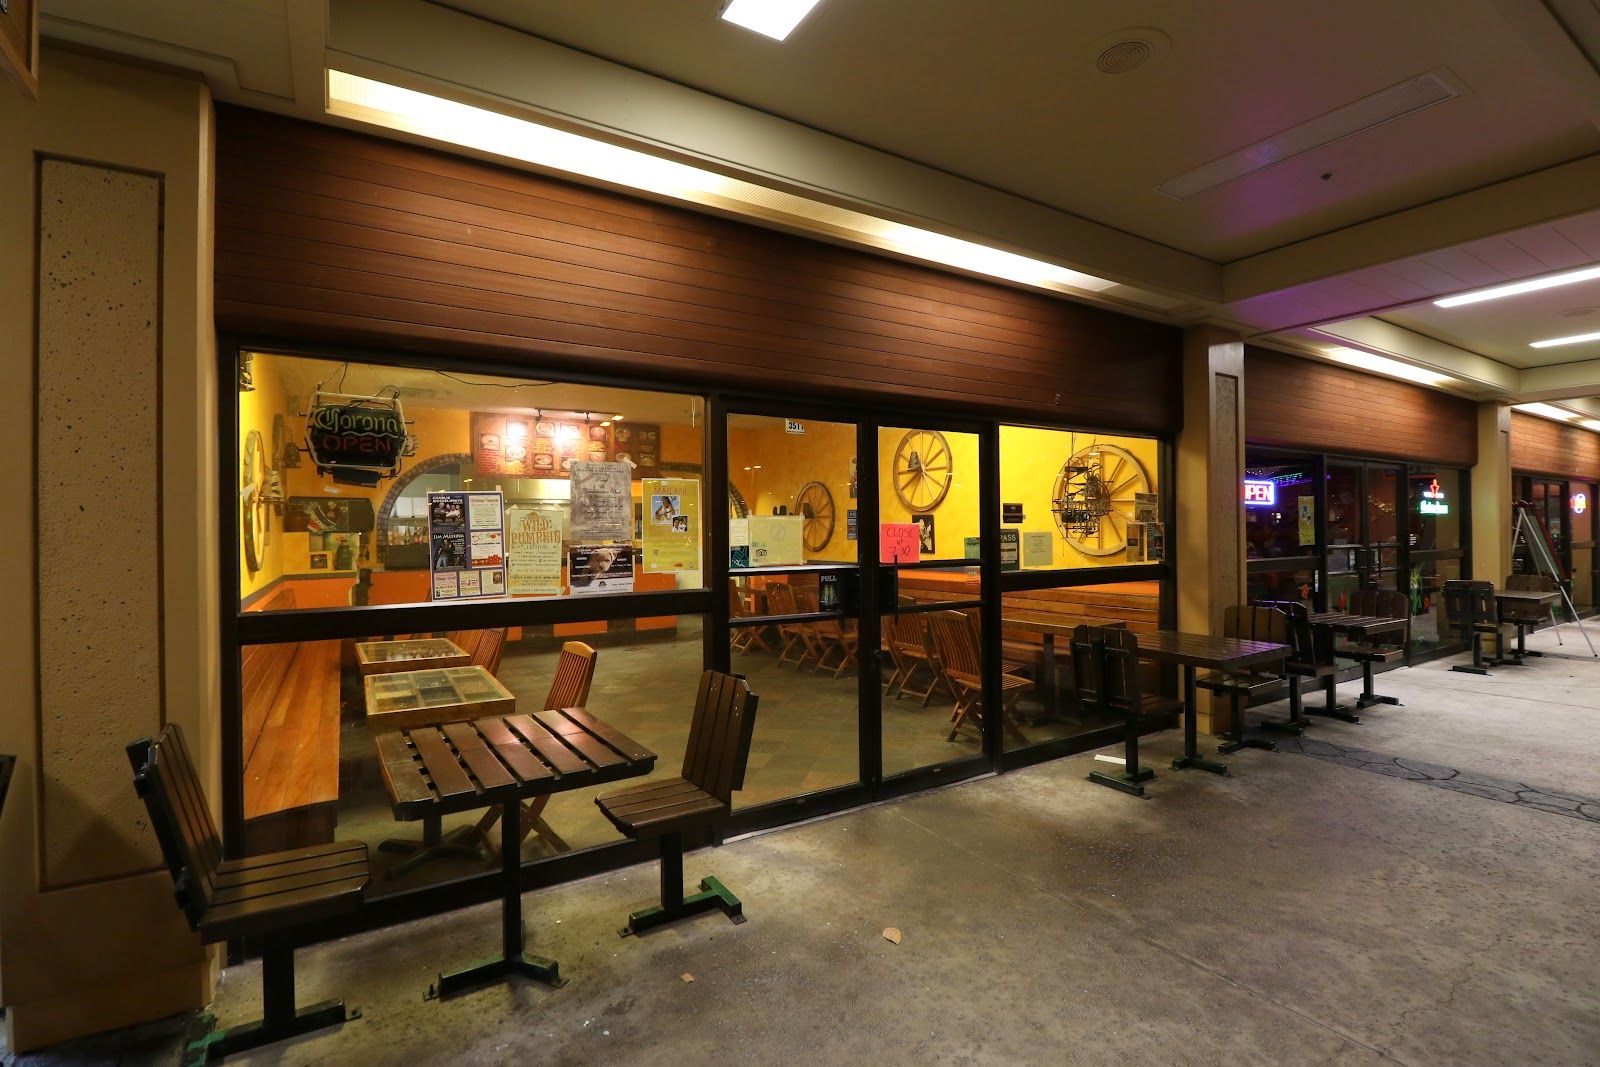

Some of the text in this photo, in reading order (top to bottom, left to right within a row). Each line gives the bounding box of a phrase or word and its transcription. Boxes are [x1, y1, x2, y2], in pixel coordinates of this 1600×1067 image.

[314, 408, 399, 433] Corona
[323, 435, 391, 453] OPEN
[653, 487, 688, 496] MAILANI
[522, 519, 549, 532] WILD
[511, 531, 561, 545] PUMPKIN
